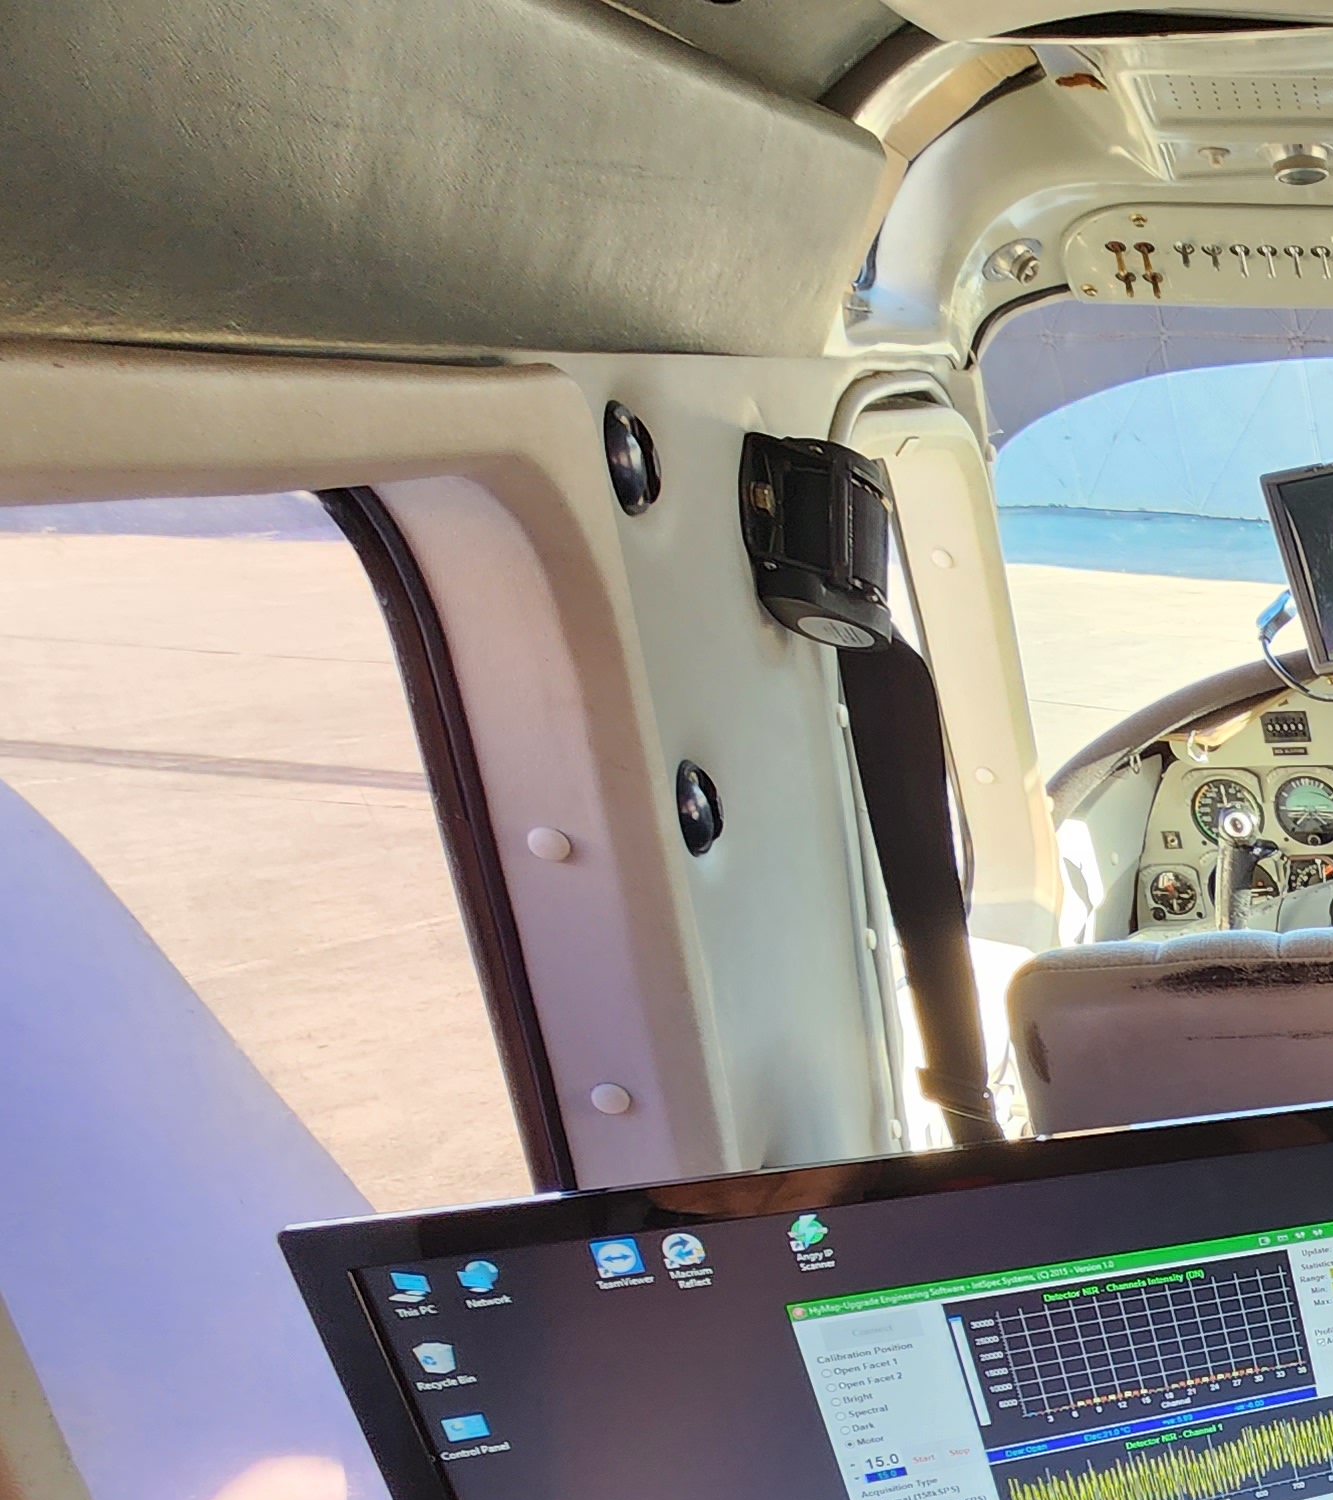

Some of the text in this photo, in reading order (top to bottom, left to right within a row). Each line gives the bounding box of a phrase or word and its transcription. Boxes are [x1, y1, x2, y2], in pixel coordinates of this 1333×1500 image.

[797, 1248, 833, 1263] Angry IP
[800, 1260, 835, 1271] Scanner
[669, 1267, 714, 1280] Macrium
[596, 1275, 655, 1290] TeamViewer
[678, 1277, 712, 1289] Reflect
[880, 1289, 929, 1306] Engineering
[930, 1282, 965, 1298] Software
[970, 1277, 1000, 1291] IntSpec
[1036, 1269, 1049, 1281] (C)
[1049, 1267, 1068, 1278] 2015
[1073, 1263, 1100, 1275] Version
[1102, 1260, 1115, 1271] 1.0
[1043, 1287, 1080, 1303] Detector
[1083, 1284, 1099, 1297] NIR
[1106, 1277, 1146, 1293] Channels
[1148, 1273, 1184, 1289] Intensity
[466, 1295, 512, 1309] Network
[396, 1305, 438, 1319] This PC
[816, 1340, 913, 1366] Calibration Position
[833, 1364, 862, 1377] Open
[863, 1358, 891, 1373] Facet
[416, 1374, 477, 1392] Recycle Bin
[838, 1377, 865, 1391] Open
[867, 1372, 894, 1388] Facet
[842, 1391, 873, 1405] Bright
[848, 1403, 888, 1420] Spectral
[852, 1422, 875, 1433] Dark
[856, 1434, 884, 1447] Motor
[1125, 1435, 1161, 1450] Detector
[1161, 1431, 1177, 1444] NIR
[1182, 1425, 1214, 1439] Channel
[440, 1441, 511, 1461] Control Panel
[913, 1453, 935, 1464] Start
[949, 1447, 971, 1458] Stop
[865, 1453, 900, 1471] 15.0
[861, 1476, 938, 1498] Acquisition Type
